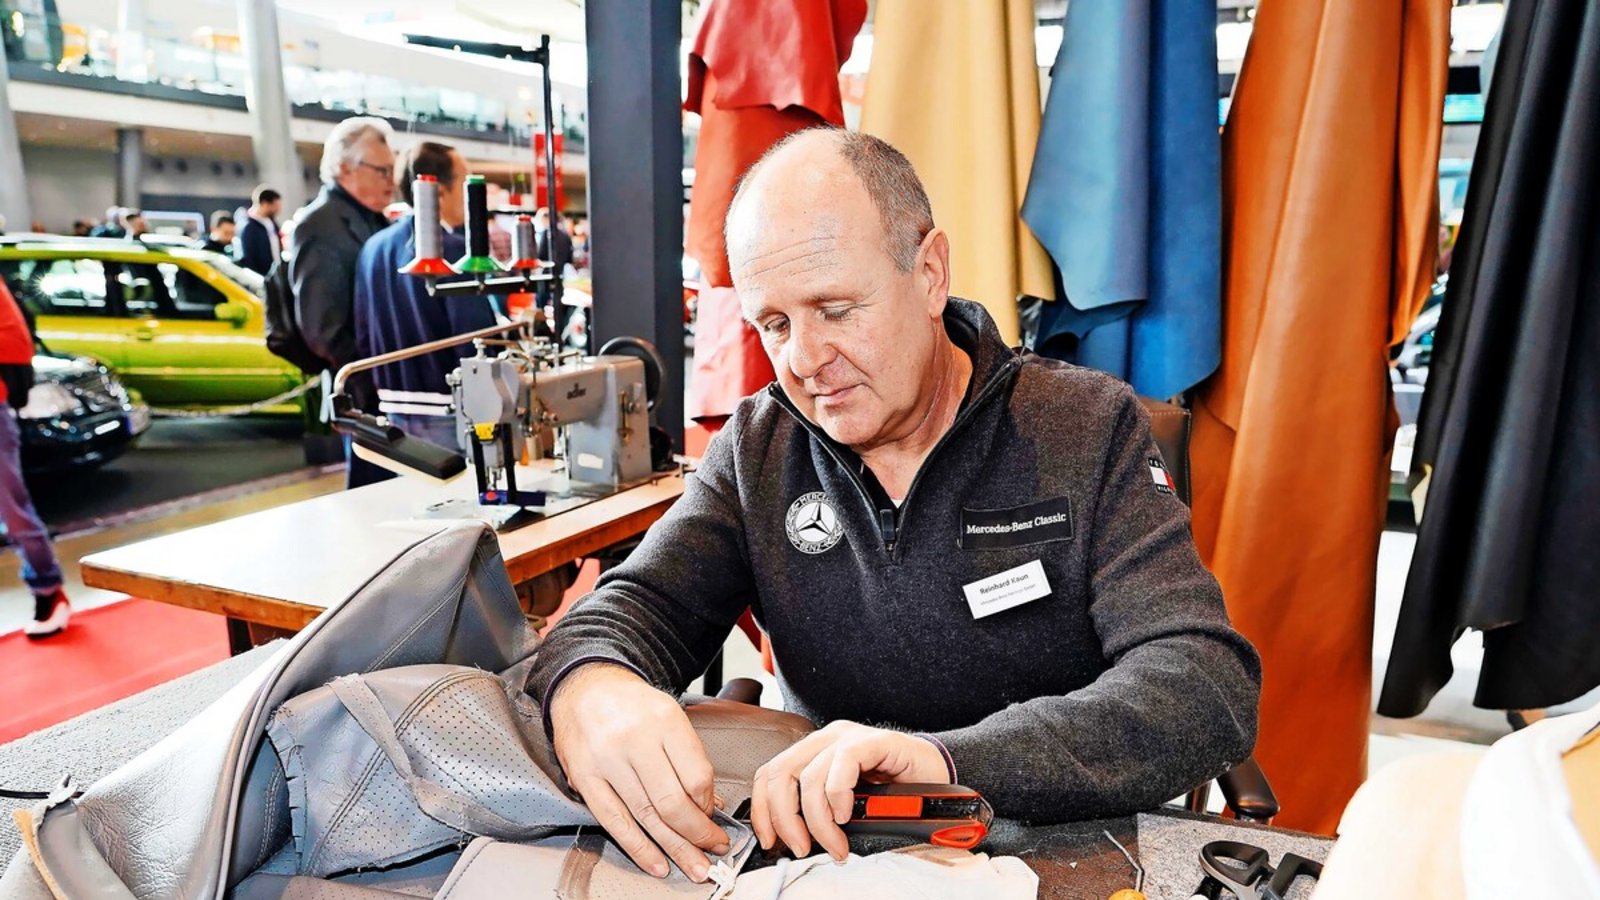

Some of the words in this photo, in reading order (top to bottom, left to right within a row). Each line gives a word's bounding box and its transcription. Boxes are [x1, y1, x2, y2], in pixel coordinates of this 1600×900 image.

[966, 520, 1033, 535] Mercedes-Benz
[1034, 512, 1067, 527] Classic
[979, 579, 1011, 595] Reinhard
